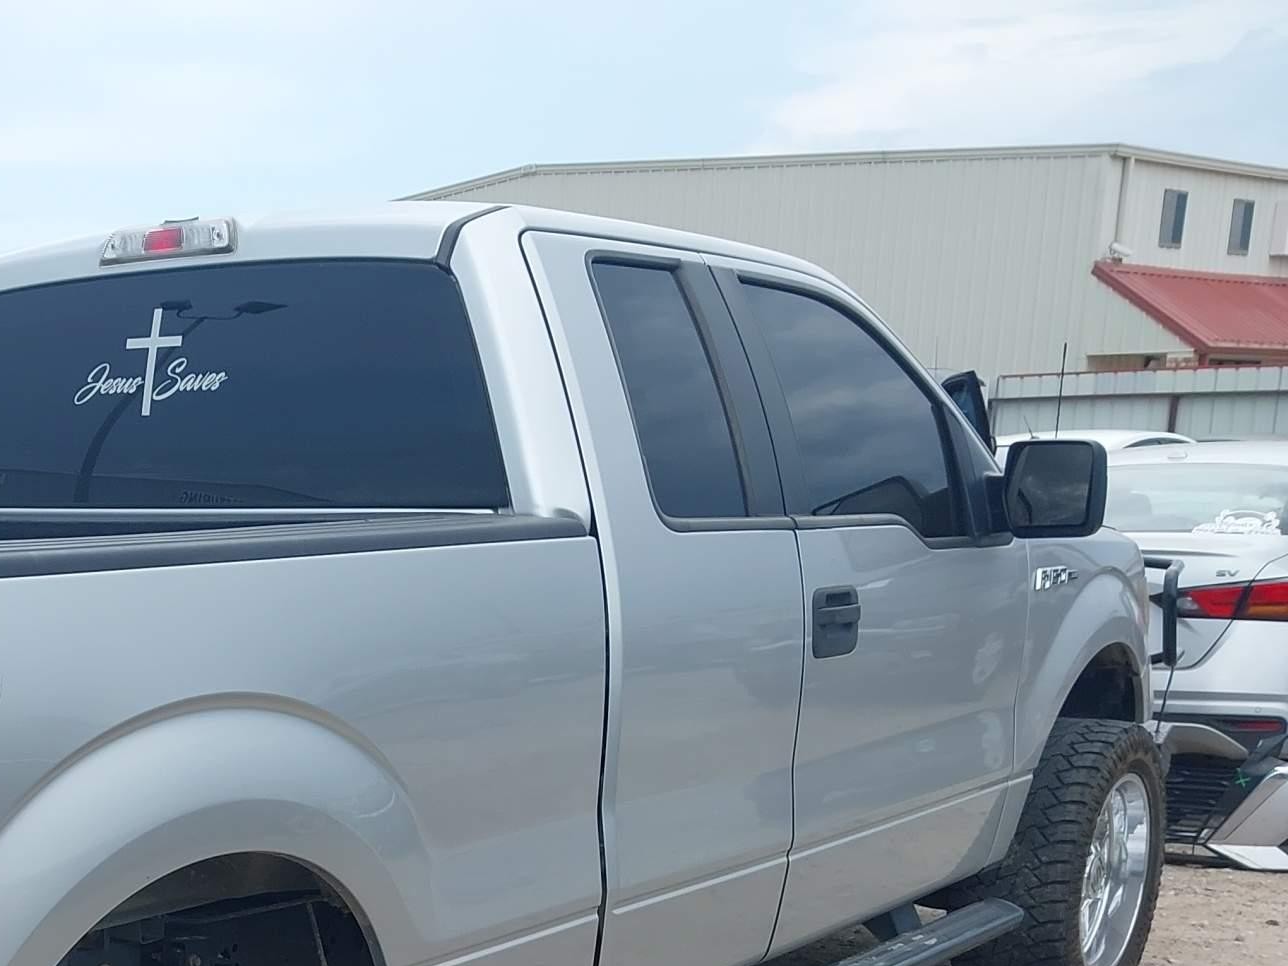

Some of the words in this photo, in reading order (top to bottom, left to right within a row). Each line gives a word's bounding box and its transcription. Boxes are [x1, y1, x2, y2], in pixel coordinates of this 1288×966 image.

[74, 362, 144, 405] Jesus
[152, 358, 228, 401] Saves
[1215, 569, 1240, 578] SV
